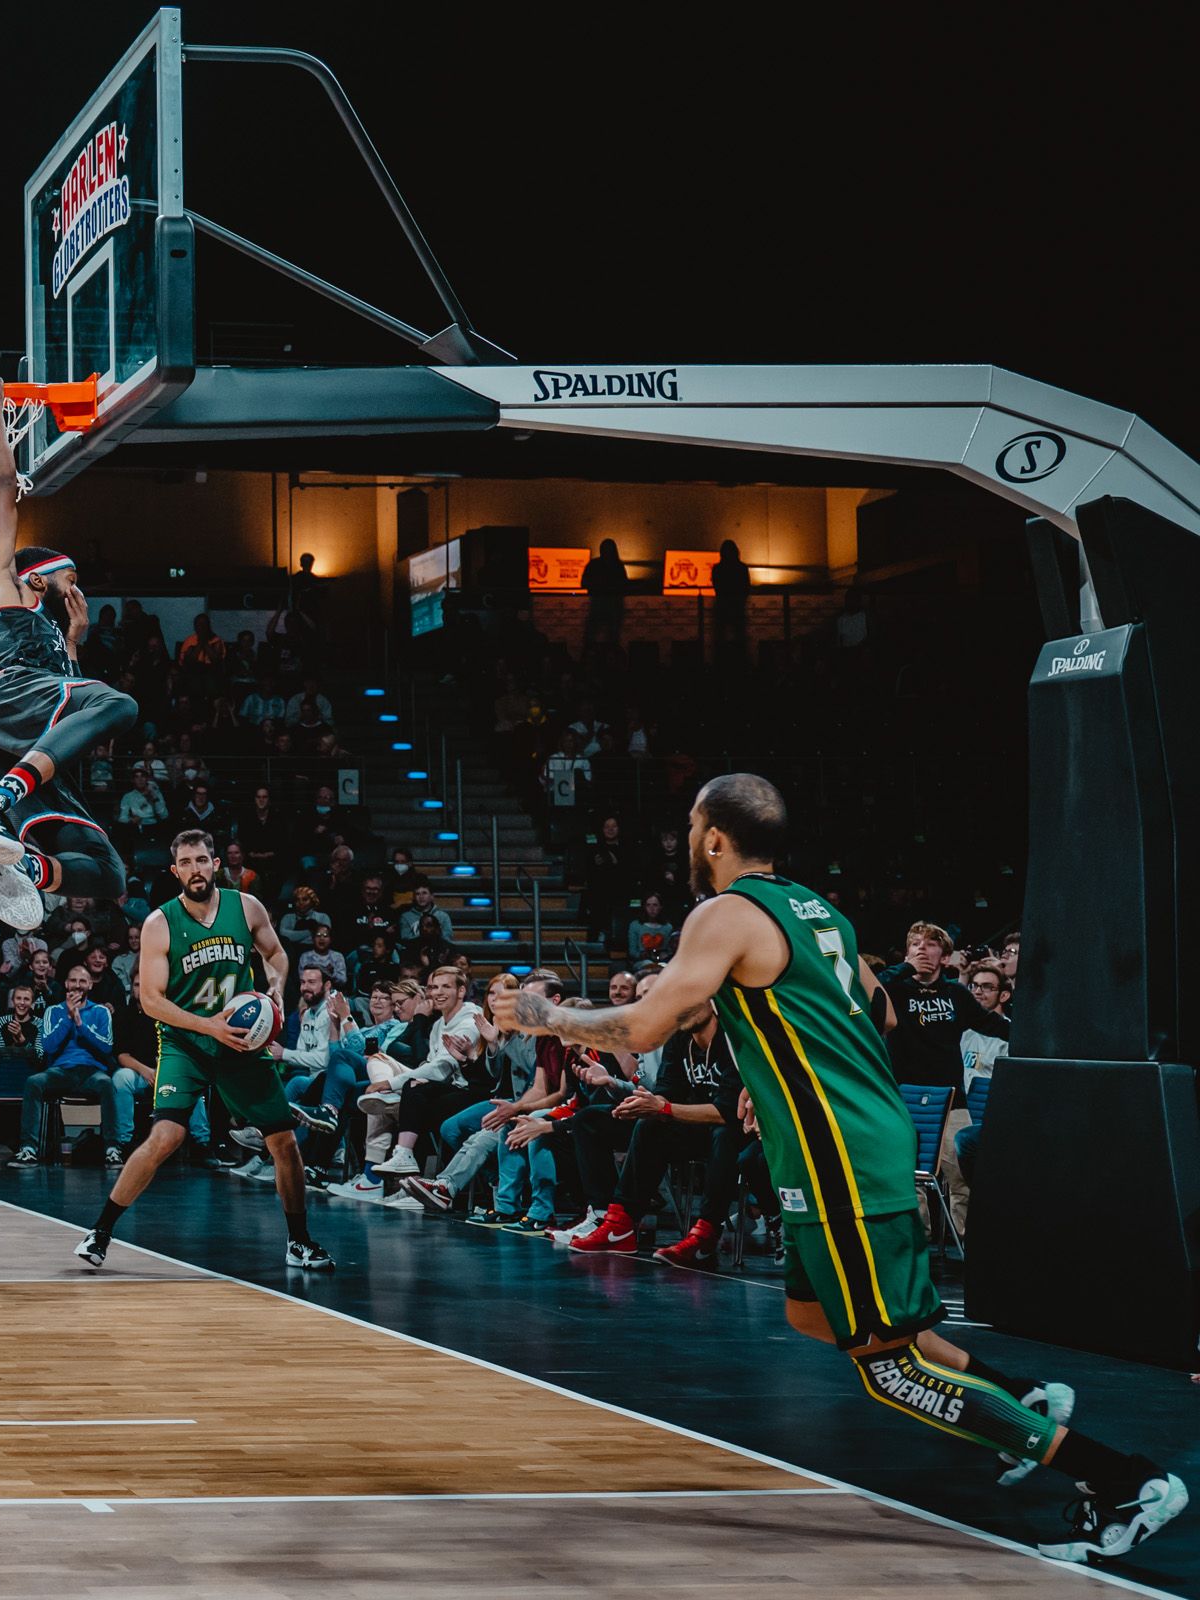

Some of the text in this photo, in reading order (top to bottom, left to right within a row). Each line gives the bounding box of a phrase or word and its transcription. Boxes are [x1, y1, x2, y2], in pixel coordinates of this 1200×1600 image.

[61, 125, 117, 236] HARLEM
[53, 179, 129, 295] GLOBETROTTERS
[533, 368, 679, 402] SPALDING
[1047, 650, 1107, 677] SPALDING
[342, 778, 354, 795] C
[558, 780, 570, 797] C
[191, 936, 233, 951] WASHINGTON
[181, 944, 245, 975] GENERALS
[813, 927, 863, 1015] 7
[193, 973, 237, 1011] 41
[908, 998, 954, 1013] BKLYN
[921, 1011, 952, 1023] NETS
[869, 1358, 964, 1424] GENERALS
